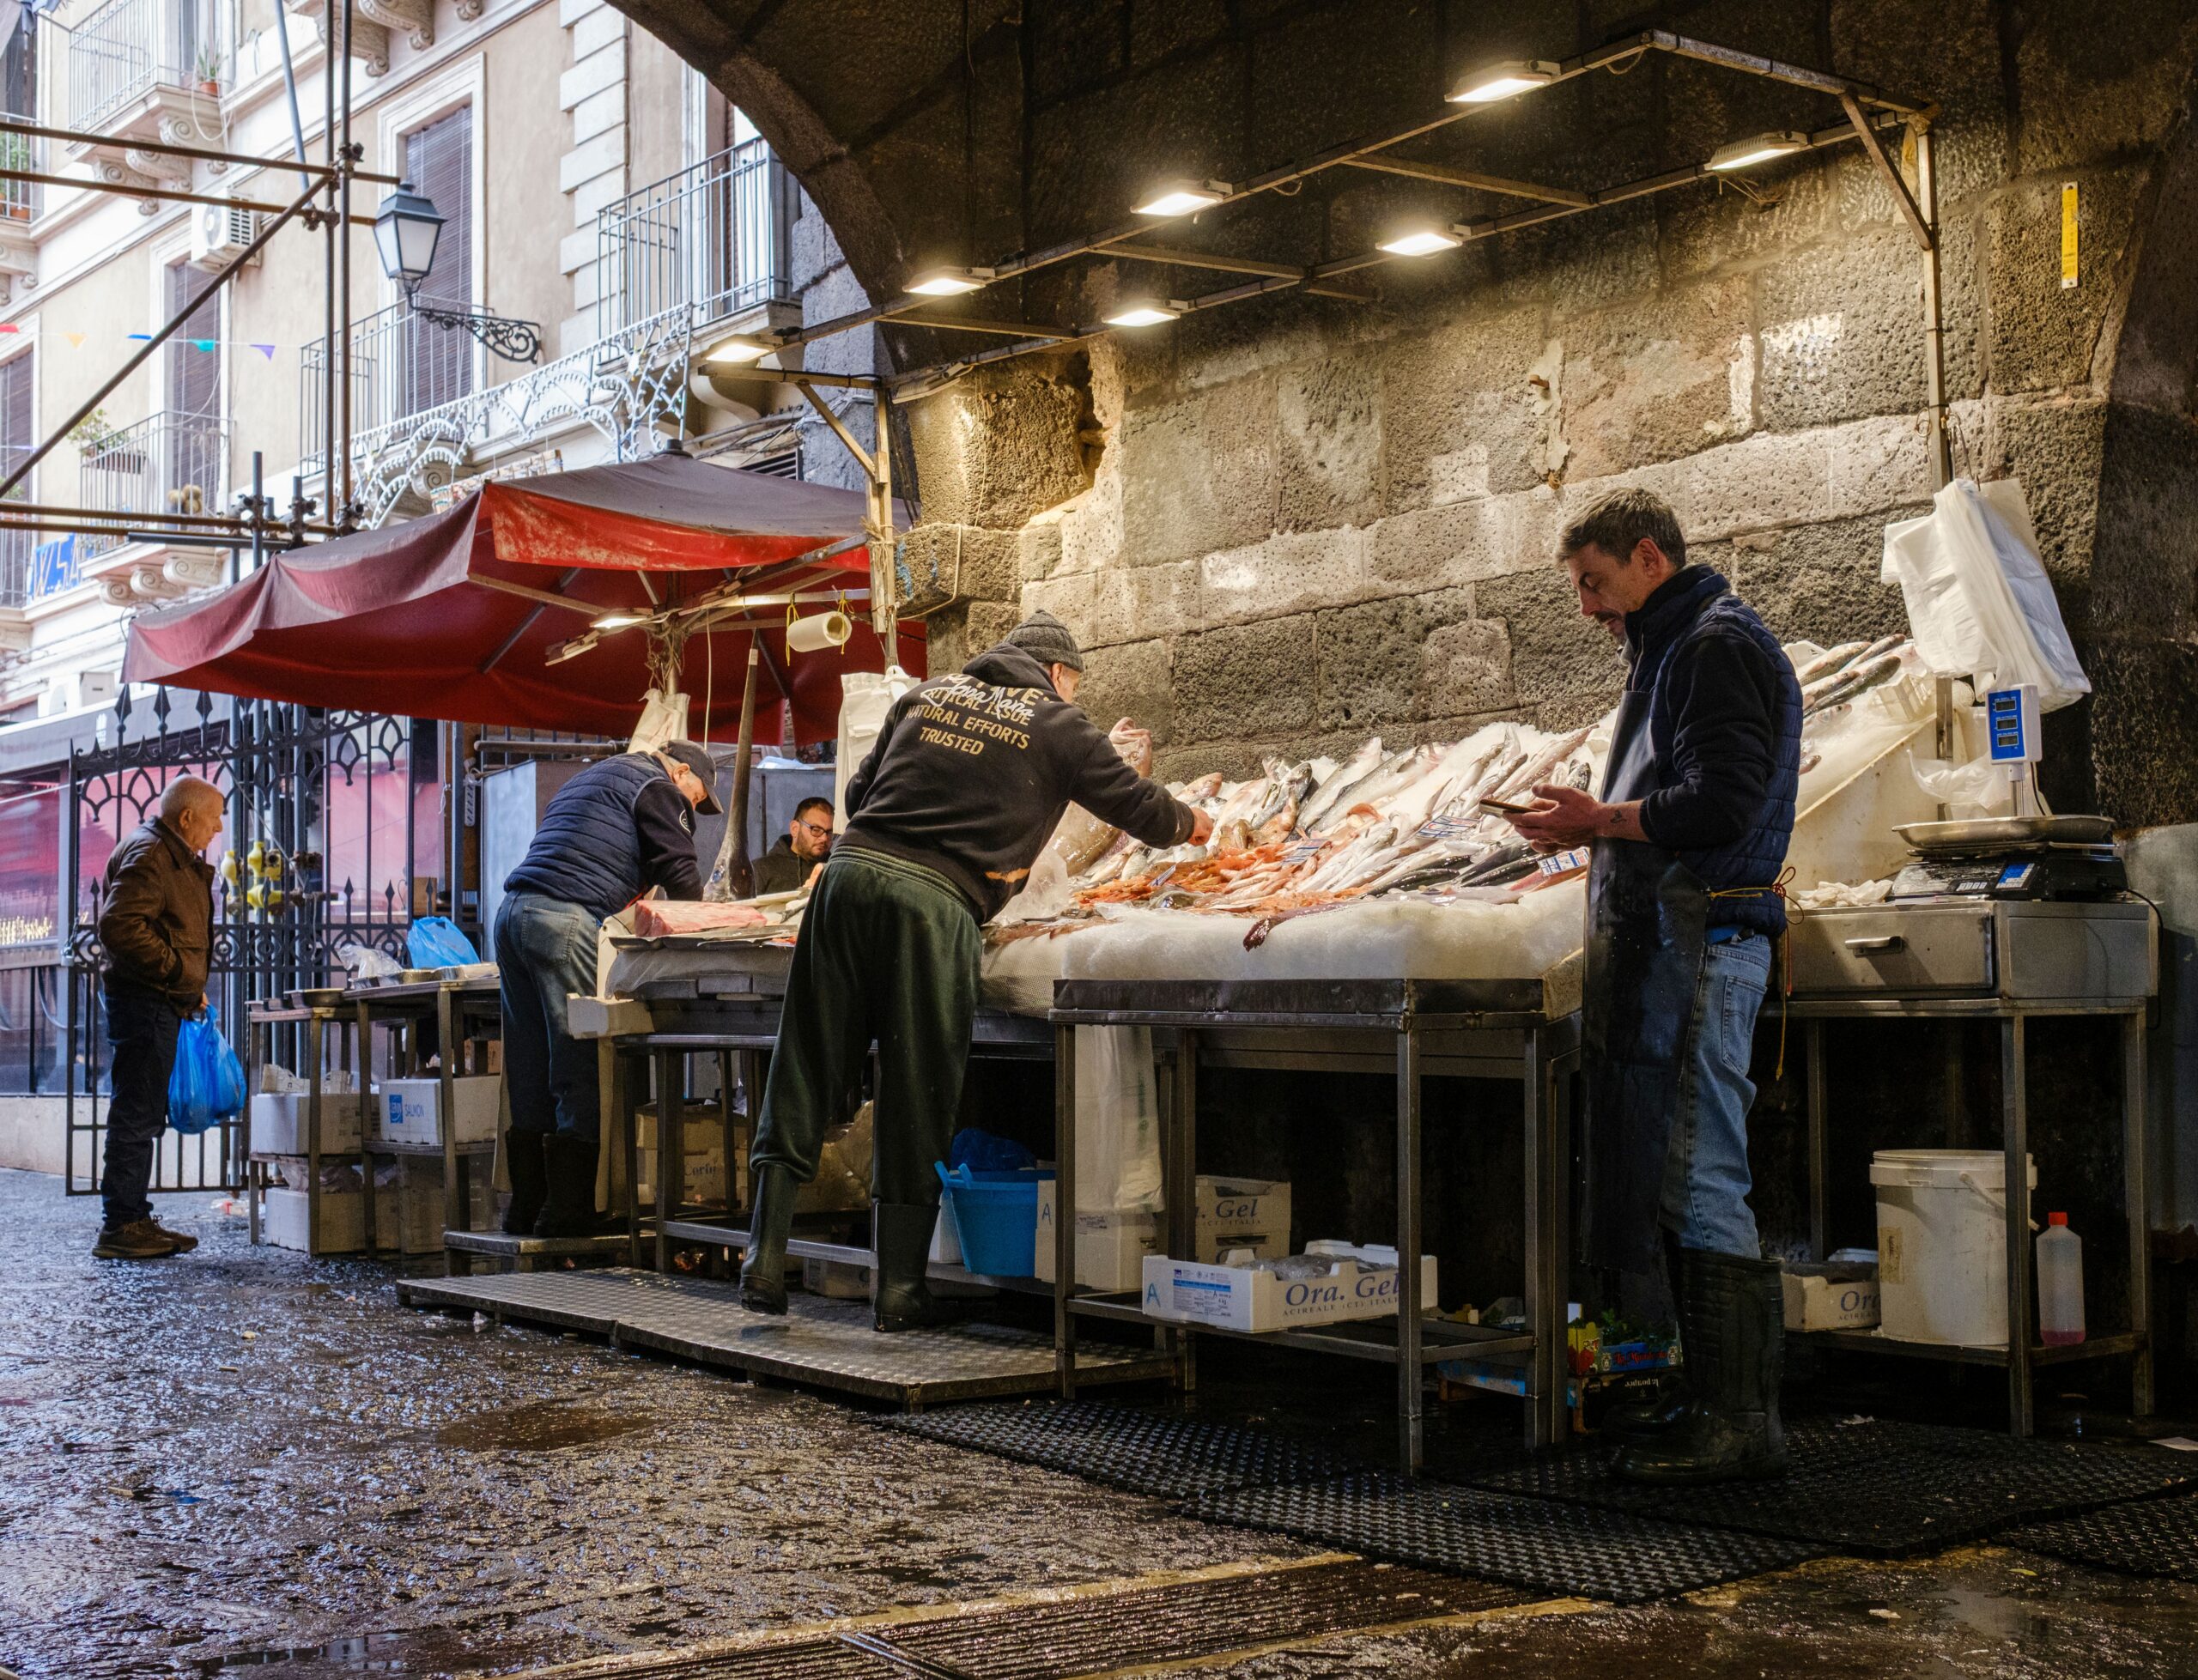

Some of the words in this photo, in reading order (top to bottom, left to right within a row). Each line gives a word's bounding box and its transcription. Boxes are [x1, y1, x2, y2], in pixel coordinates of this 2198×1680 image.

[922, 688, 981, 711] RITICAL
[984, 700, 1031, 726] ISSUE
[905, 704, 959, 727] NATURAL
[962, 716, 1031, 749] EFFORTS
[919, 726, 985, 755] TRUSTED
[1041, 1202, 1052, 1226] A
[1216, 1198, 1258, 1218] Gel
[1146, 1282, 1161, 1308] A
[1285, 1283, 1345, 1307] Ora.
[1355, 1273, 1400, 1299] Gel
[1283, 1304, 1335, 1316] ACIREALE
[1370, 1296, 1400, 1306] ITALI
